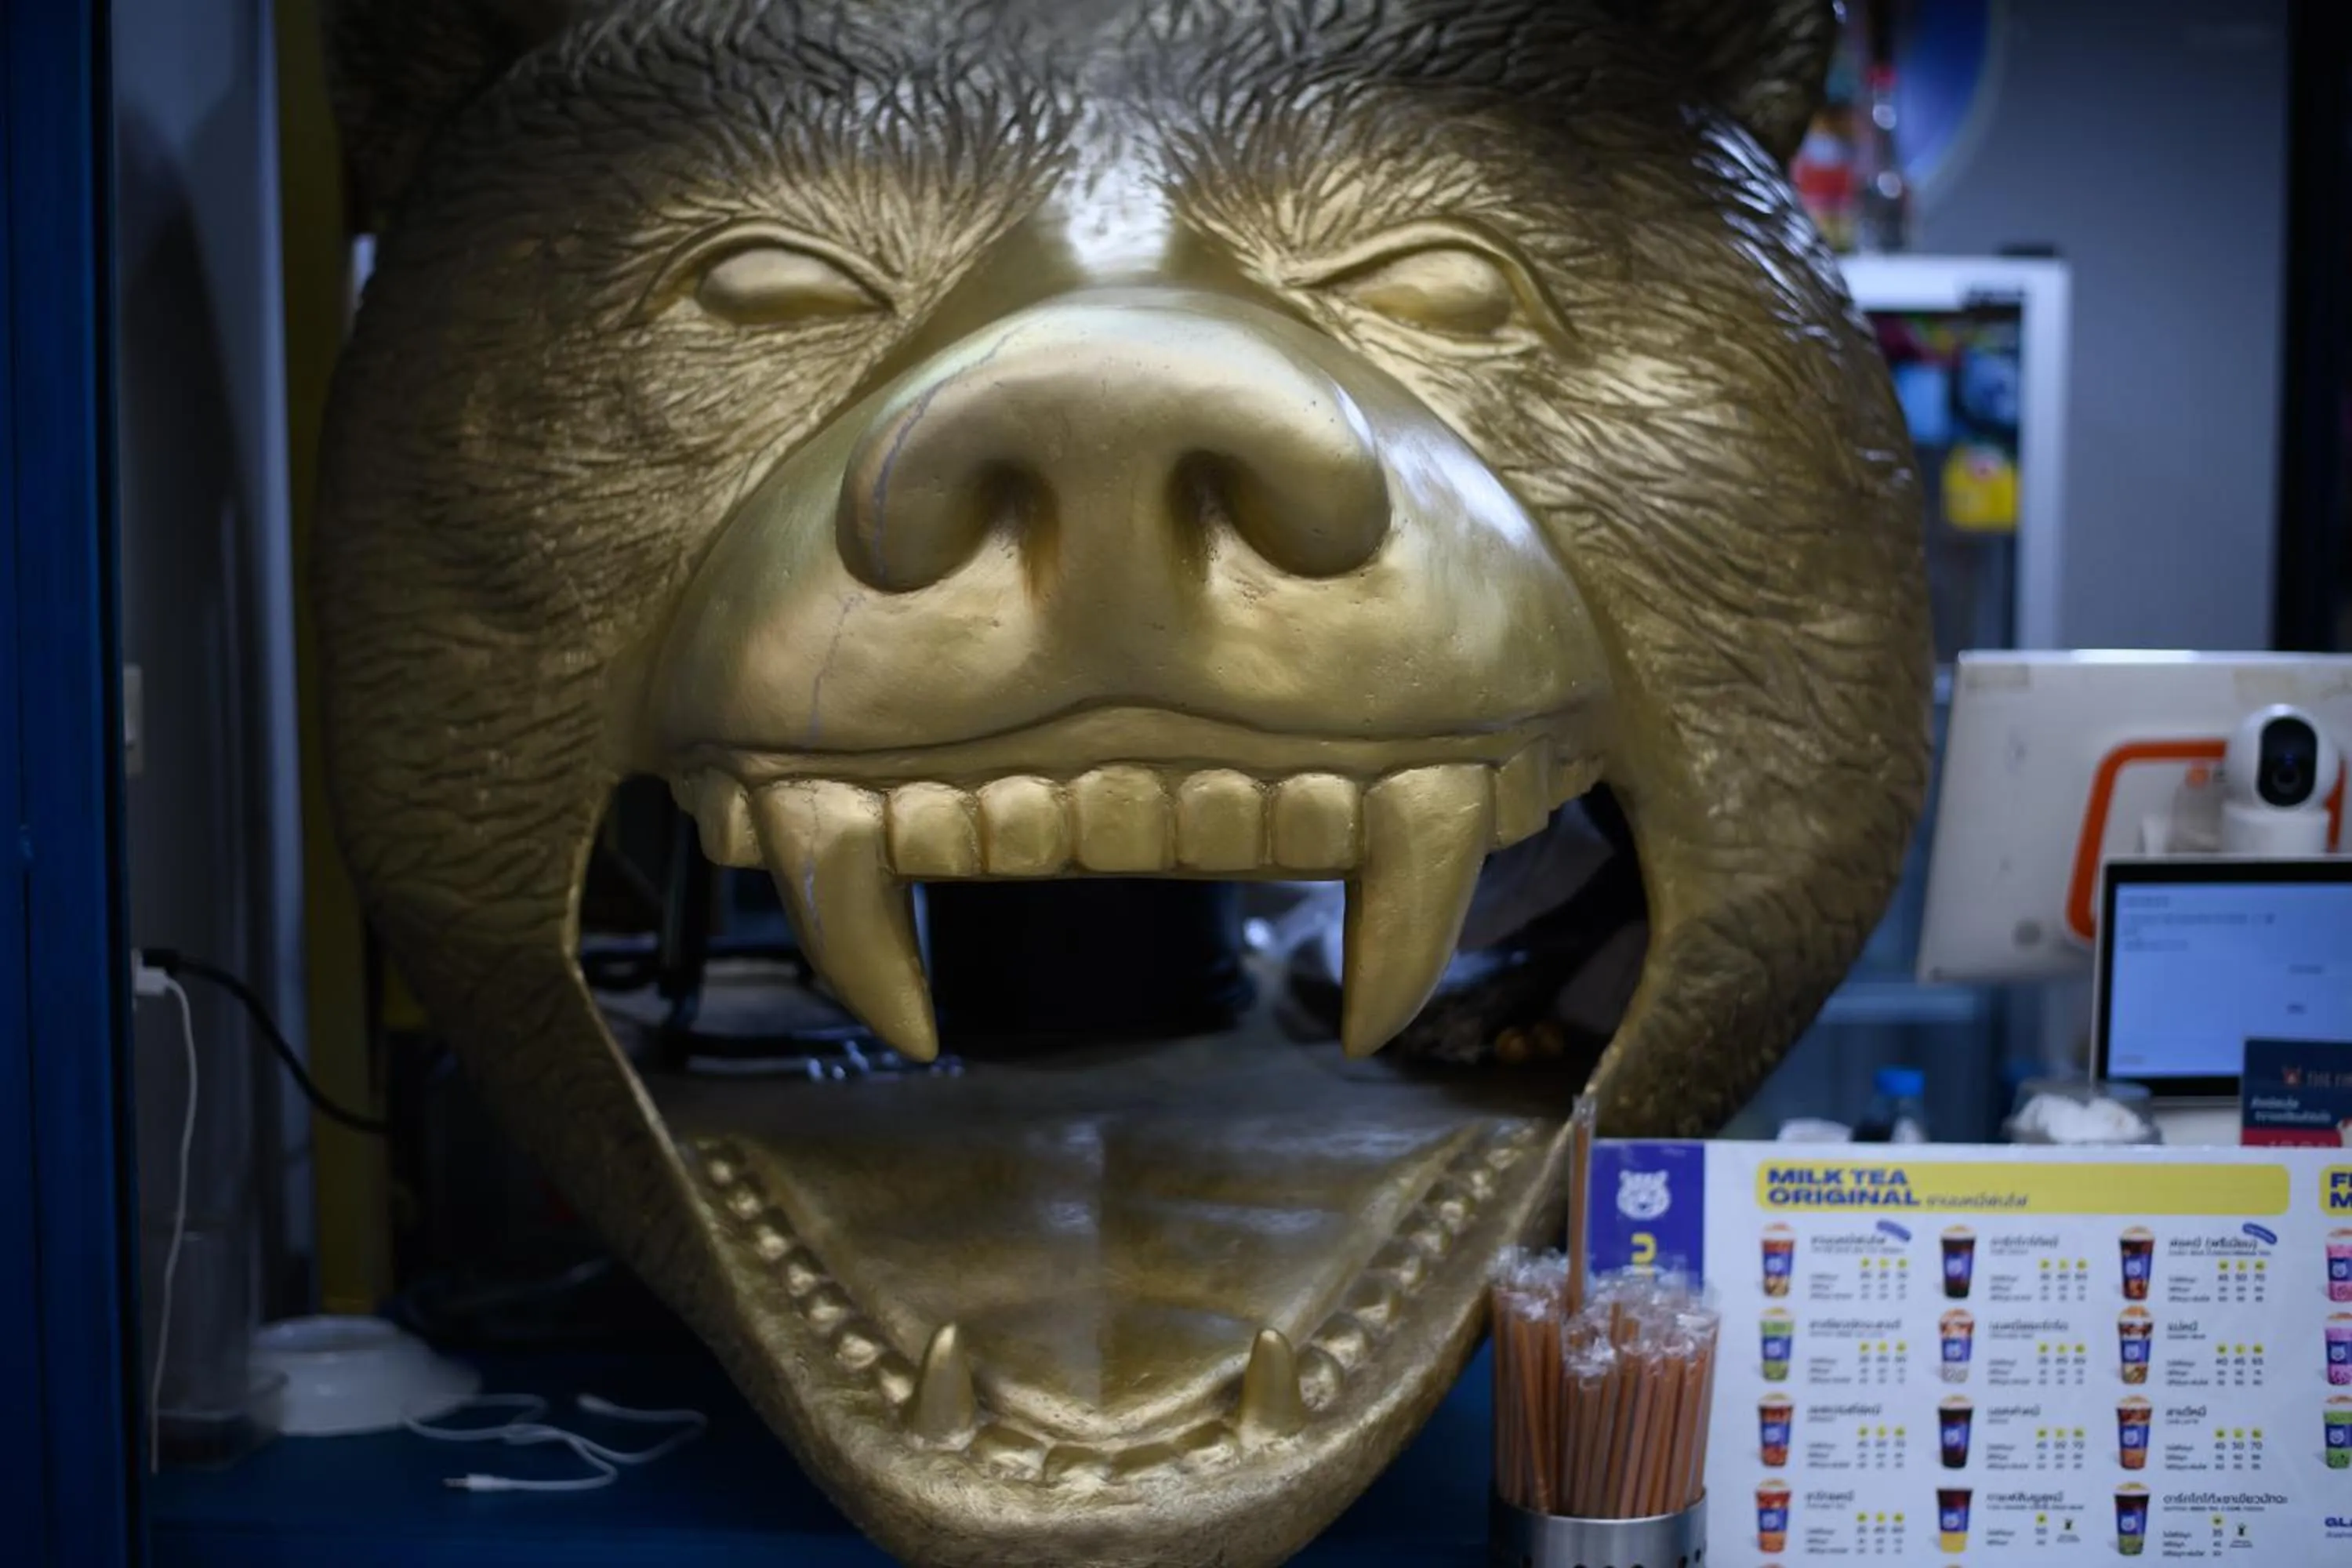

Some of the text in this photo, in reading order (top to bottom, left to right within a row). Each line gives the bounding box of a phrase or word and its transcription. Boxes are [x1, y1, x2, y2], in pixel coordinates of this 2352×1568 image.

[1767, 1168, 1908, 1185] MILK TEA
[1768, 1188, 1920, 1206] ORIGINAL
[2325, 1518, 2352, 1527] GL
